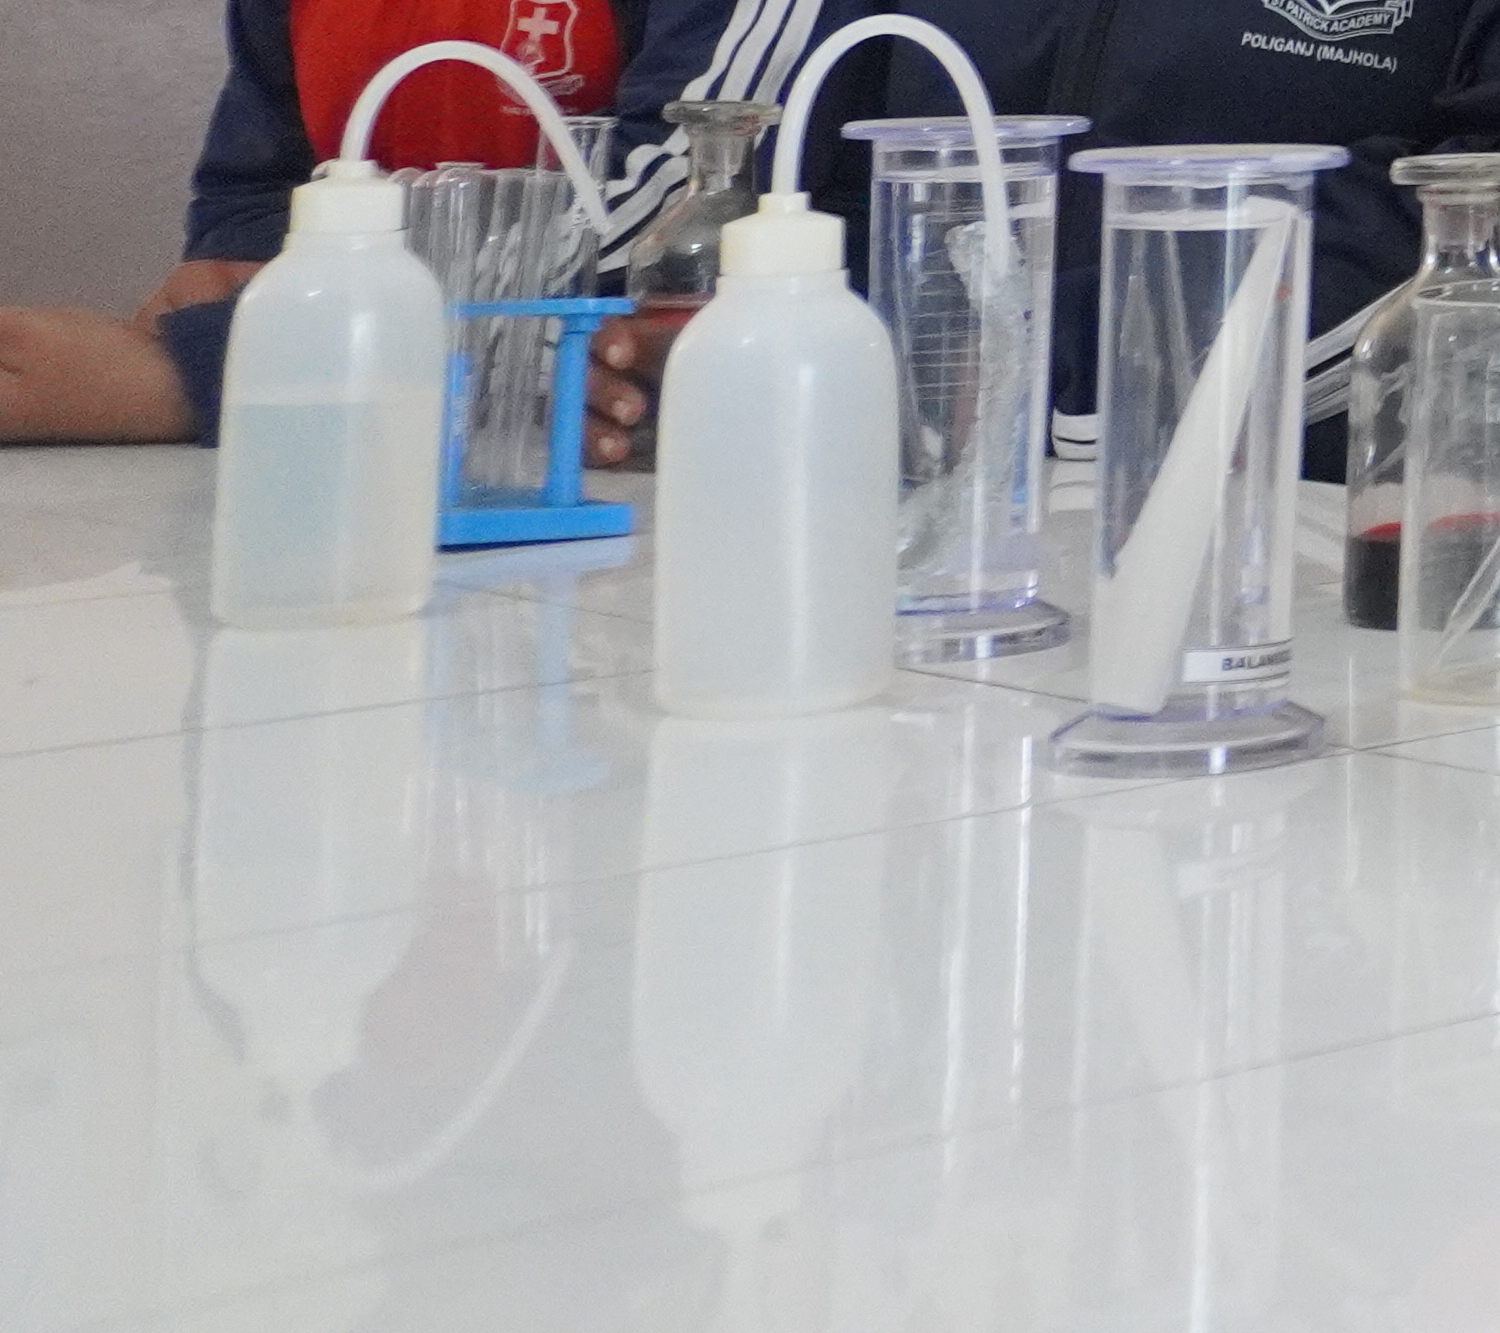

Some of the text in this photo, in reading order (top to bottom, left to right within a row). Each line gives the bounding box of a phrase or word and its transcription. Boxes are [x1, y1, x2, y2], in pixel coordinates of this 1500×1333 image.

[1286, 0, 1330, 32] PATRICK
[1330, 12, 1391, 33] ACADEMY
[1241, 32, 1398, 73] POLIGANJ (MAJHOLA)
